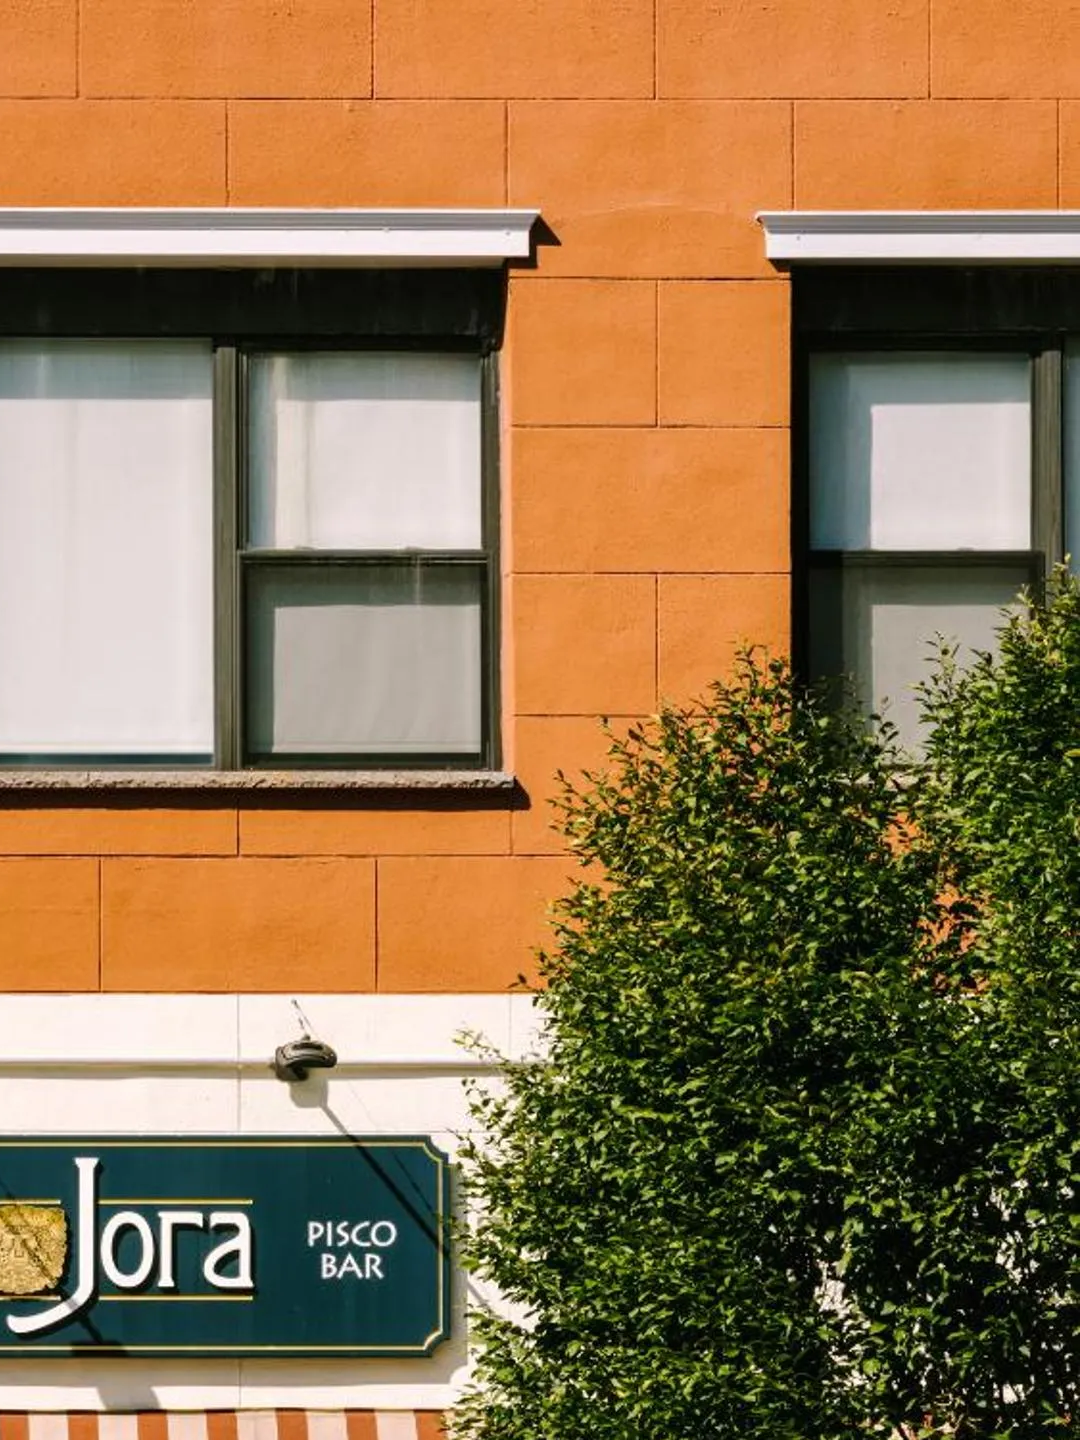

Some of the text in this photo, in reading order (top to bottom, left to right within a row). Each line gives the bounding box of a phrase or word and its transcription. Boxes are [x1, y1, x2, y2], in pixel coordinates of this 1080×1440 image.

[6, 1156, 255, 1334] Jora
[307, 1219, 398, 1248] PISCO
[320, 1253, 385, 1280] BAR
